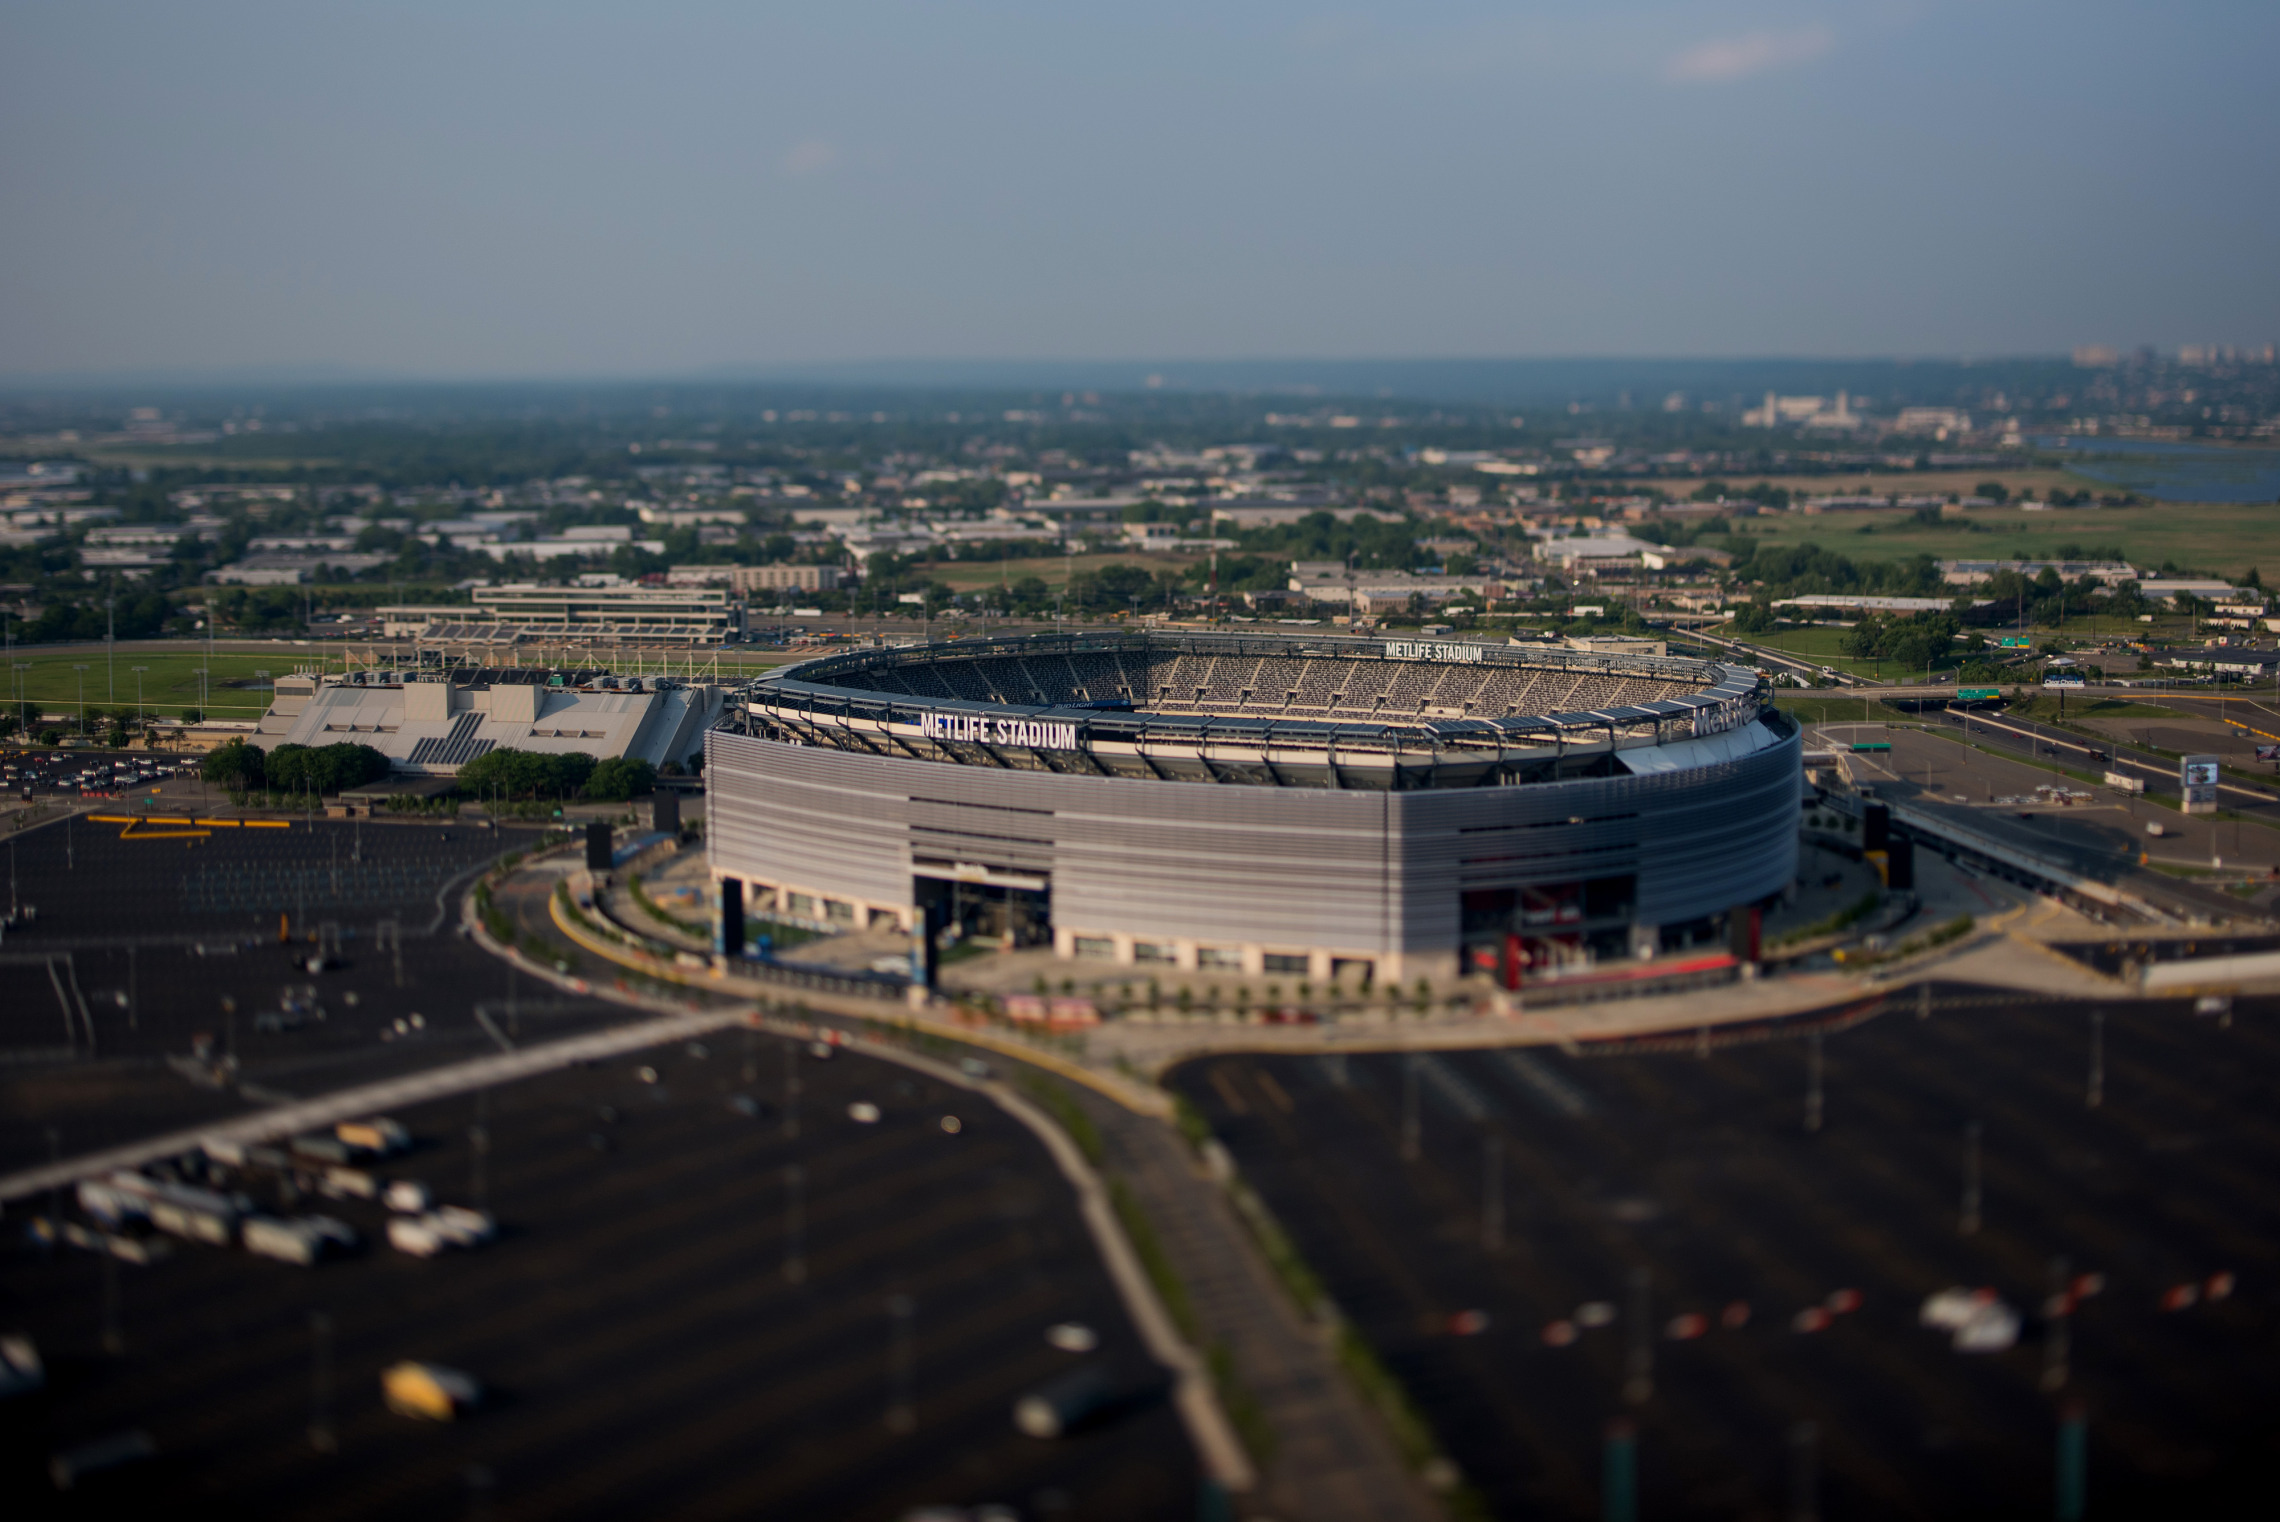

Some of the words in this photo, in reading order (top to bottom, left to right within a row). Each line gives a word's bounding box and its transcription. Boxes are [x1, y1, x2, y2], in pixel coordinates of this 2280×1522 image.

[1386, 642, 1432, 658] METLIFE
[1435, 644, 1482, 661] STADIUM
[921, 712, 991, 743] METLIFE
[997, 719, 1076, 750] STADIUM
